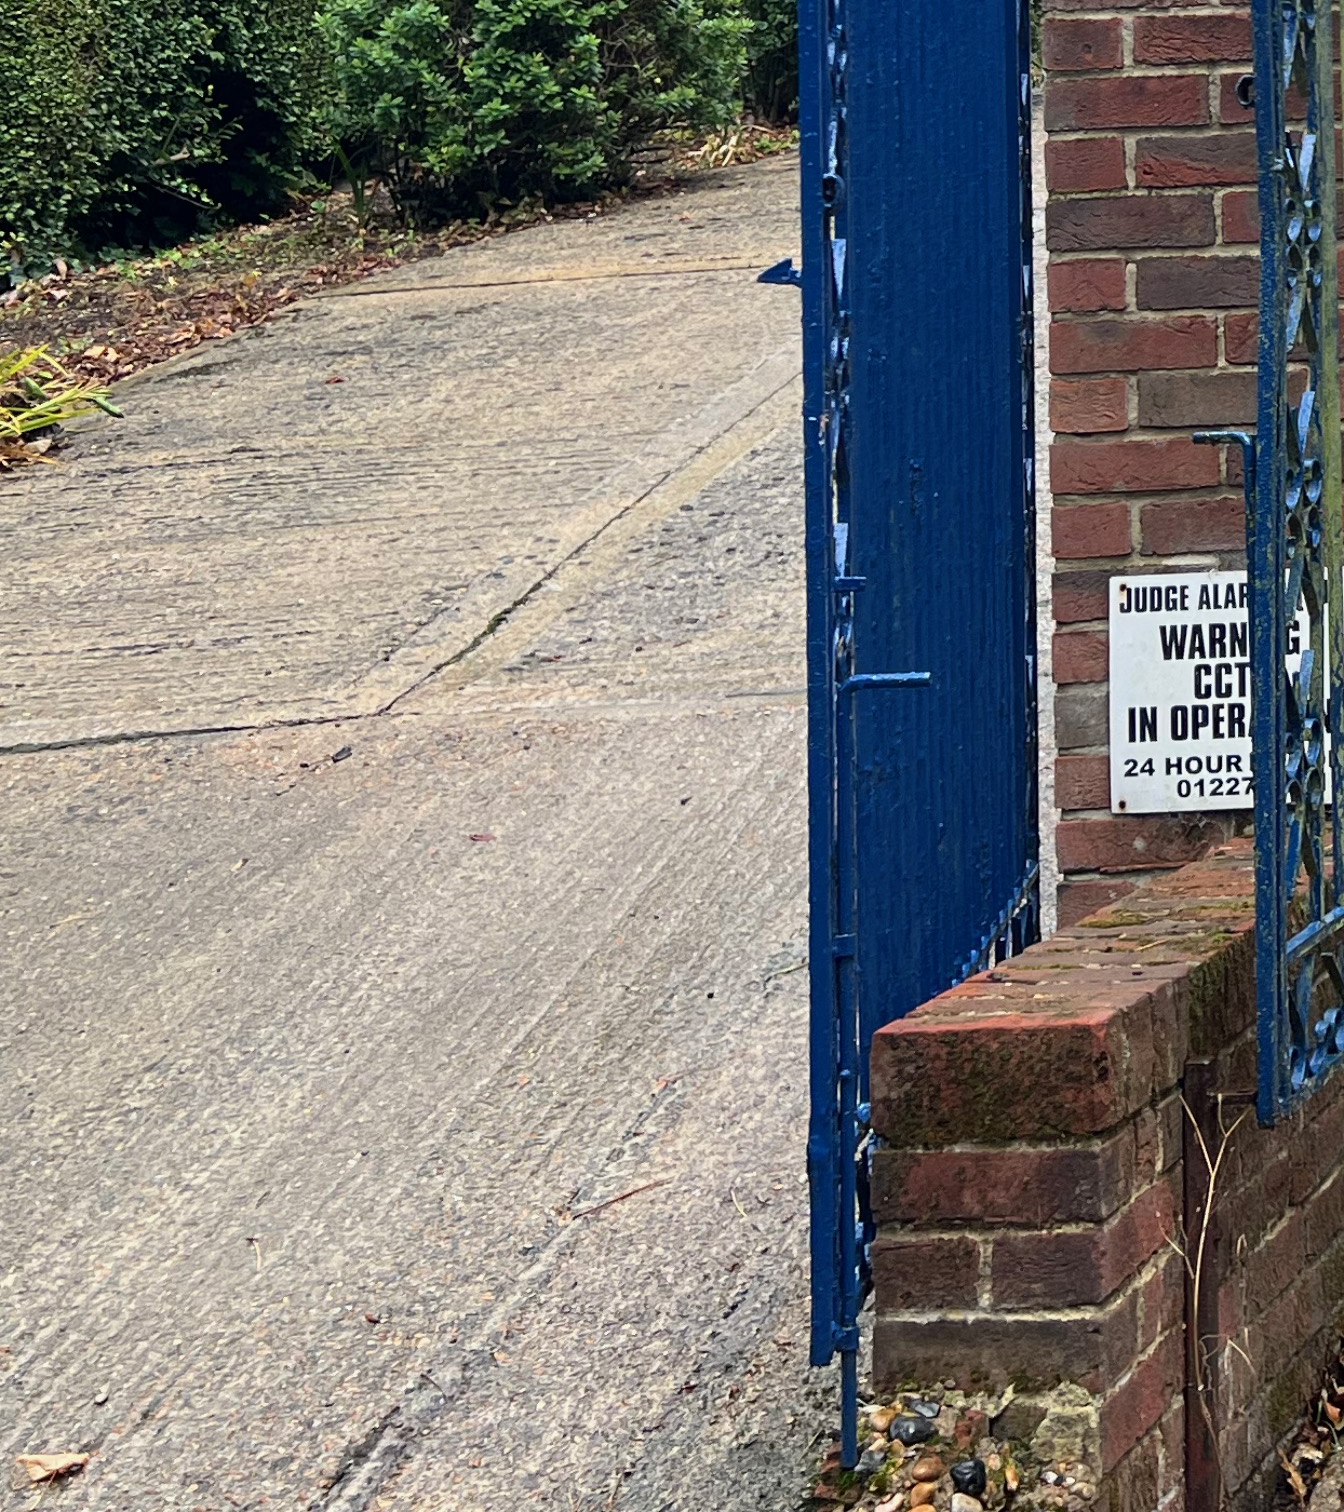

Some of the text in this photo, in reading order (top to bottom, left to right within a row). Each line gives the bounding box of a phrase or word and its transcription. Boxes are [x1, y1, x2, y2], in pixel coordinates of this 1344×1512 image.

[1119, 582, 1249, 614] JUDGE ALAR
[1159, 620, 1300, 661] WARNG
[1194, 661, 1250, 700] CCT
[1128, 705, 1158, 743] IN
[1123, 758, 1156, 778] 24
[1165, 754, 1243, 776] HOUR
